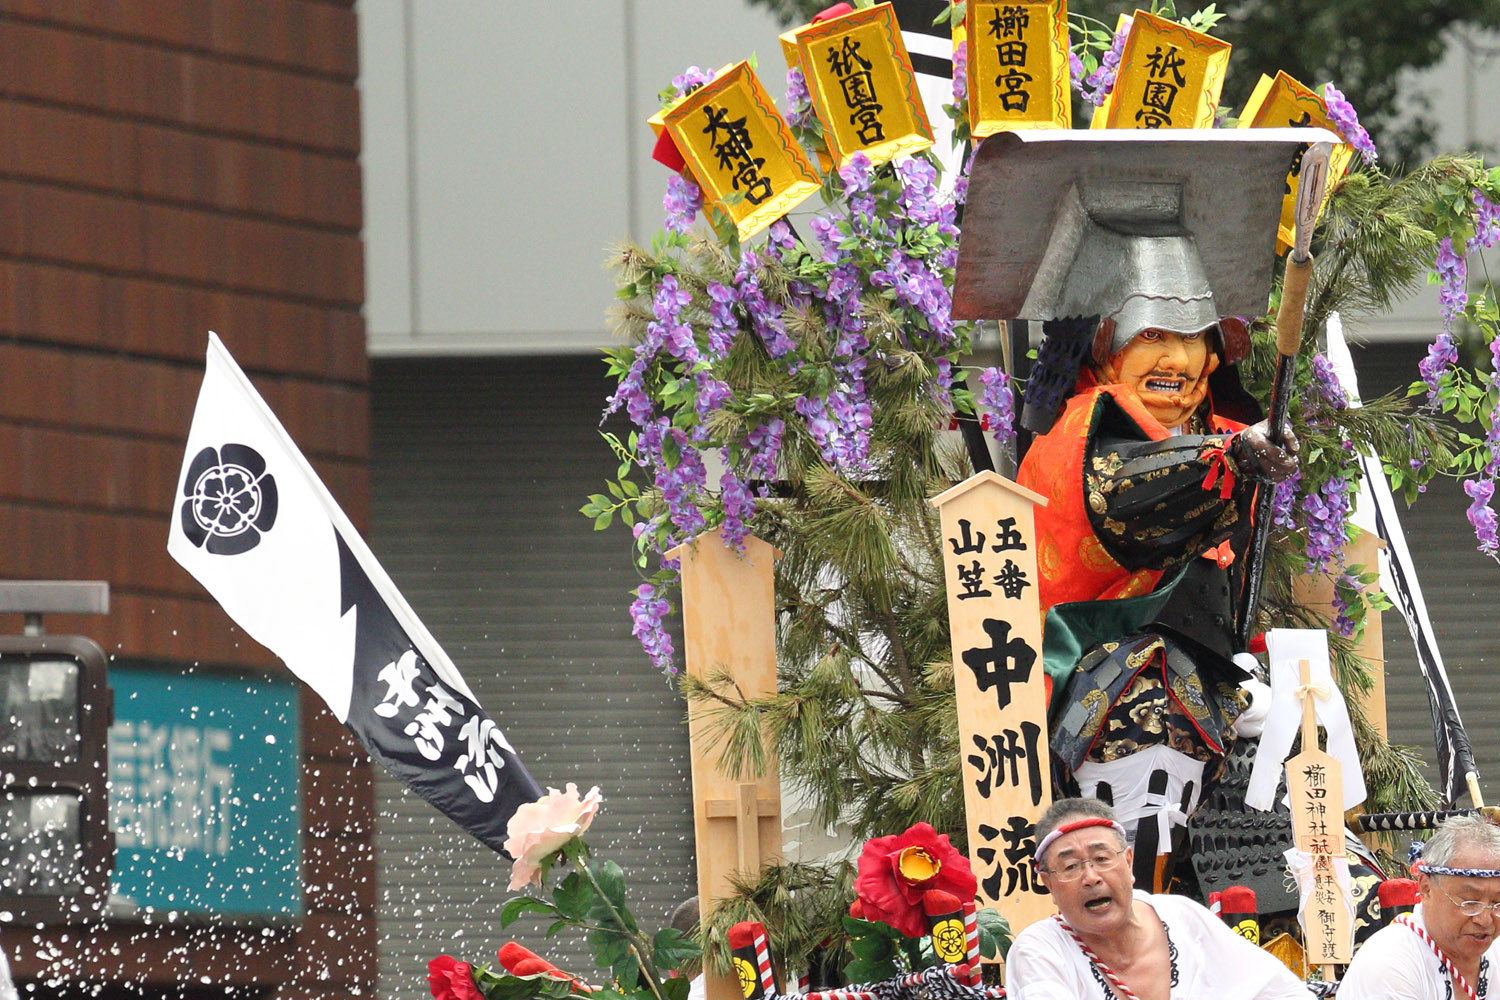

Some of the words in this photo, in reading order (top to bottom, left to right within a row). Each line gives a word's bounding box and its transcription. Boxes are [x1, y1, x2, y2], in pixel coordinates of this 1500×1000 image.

[987, 5, 1033, 113] 櫛田宮
[703, 105, 773, 205] 大神宮
[961, 618, 1051, 901] 中洲流
